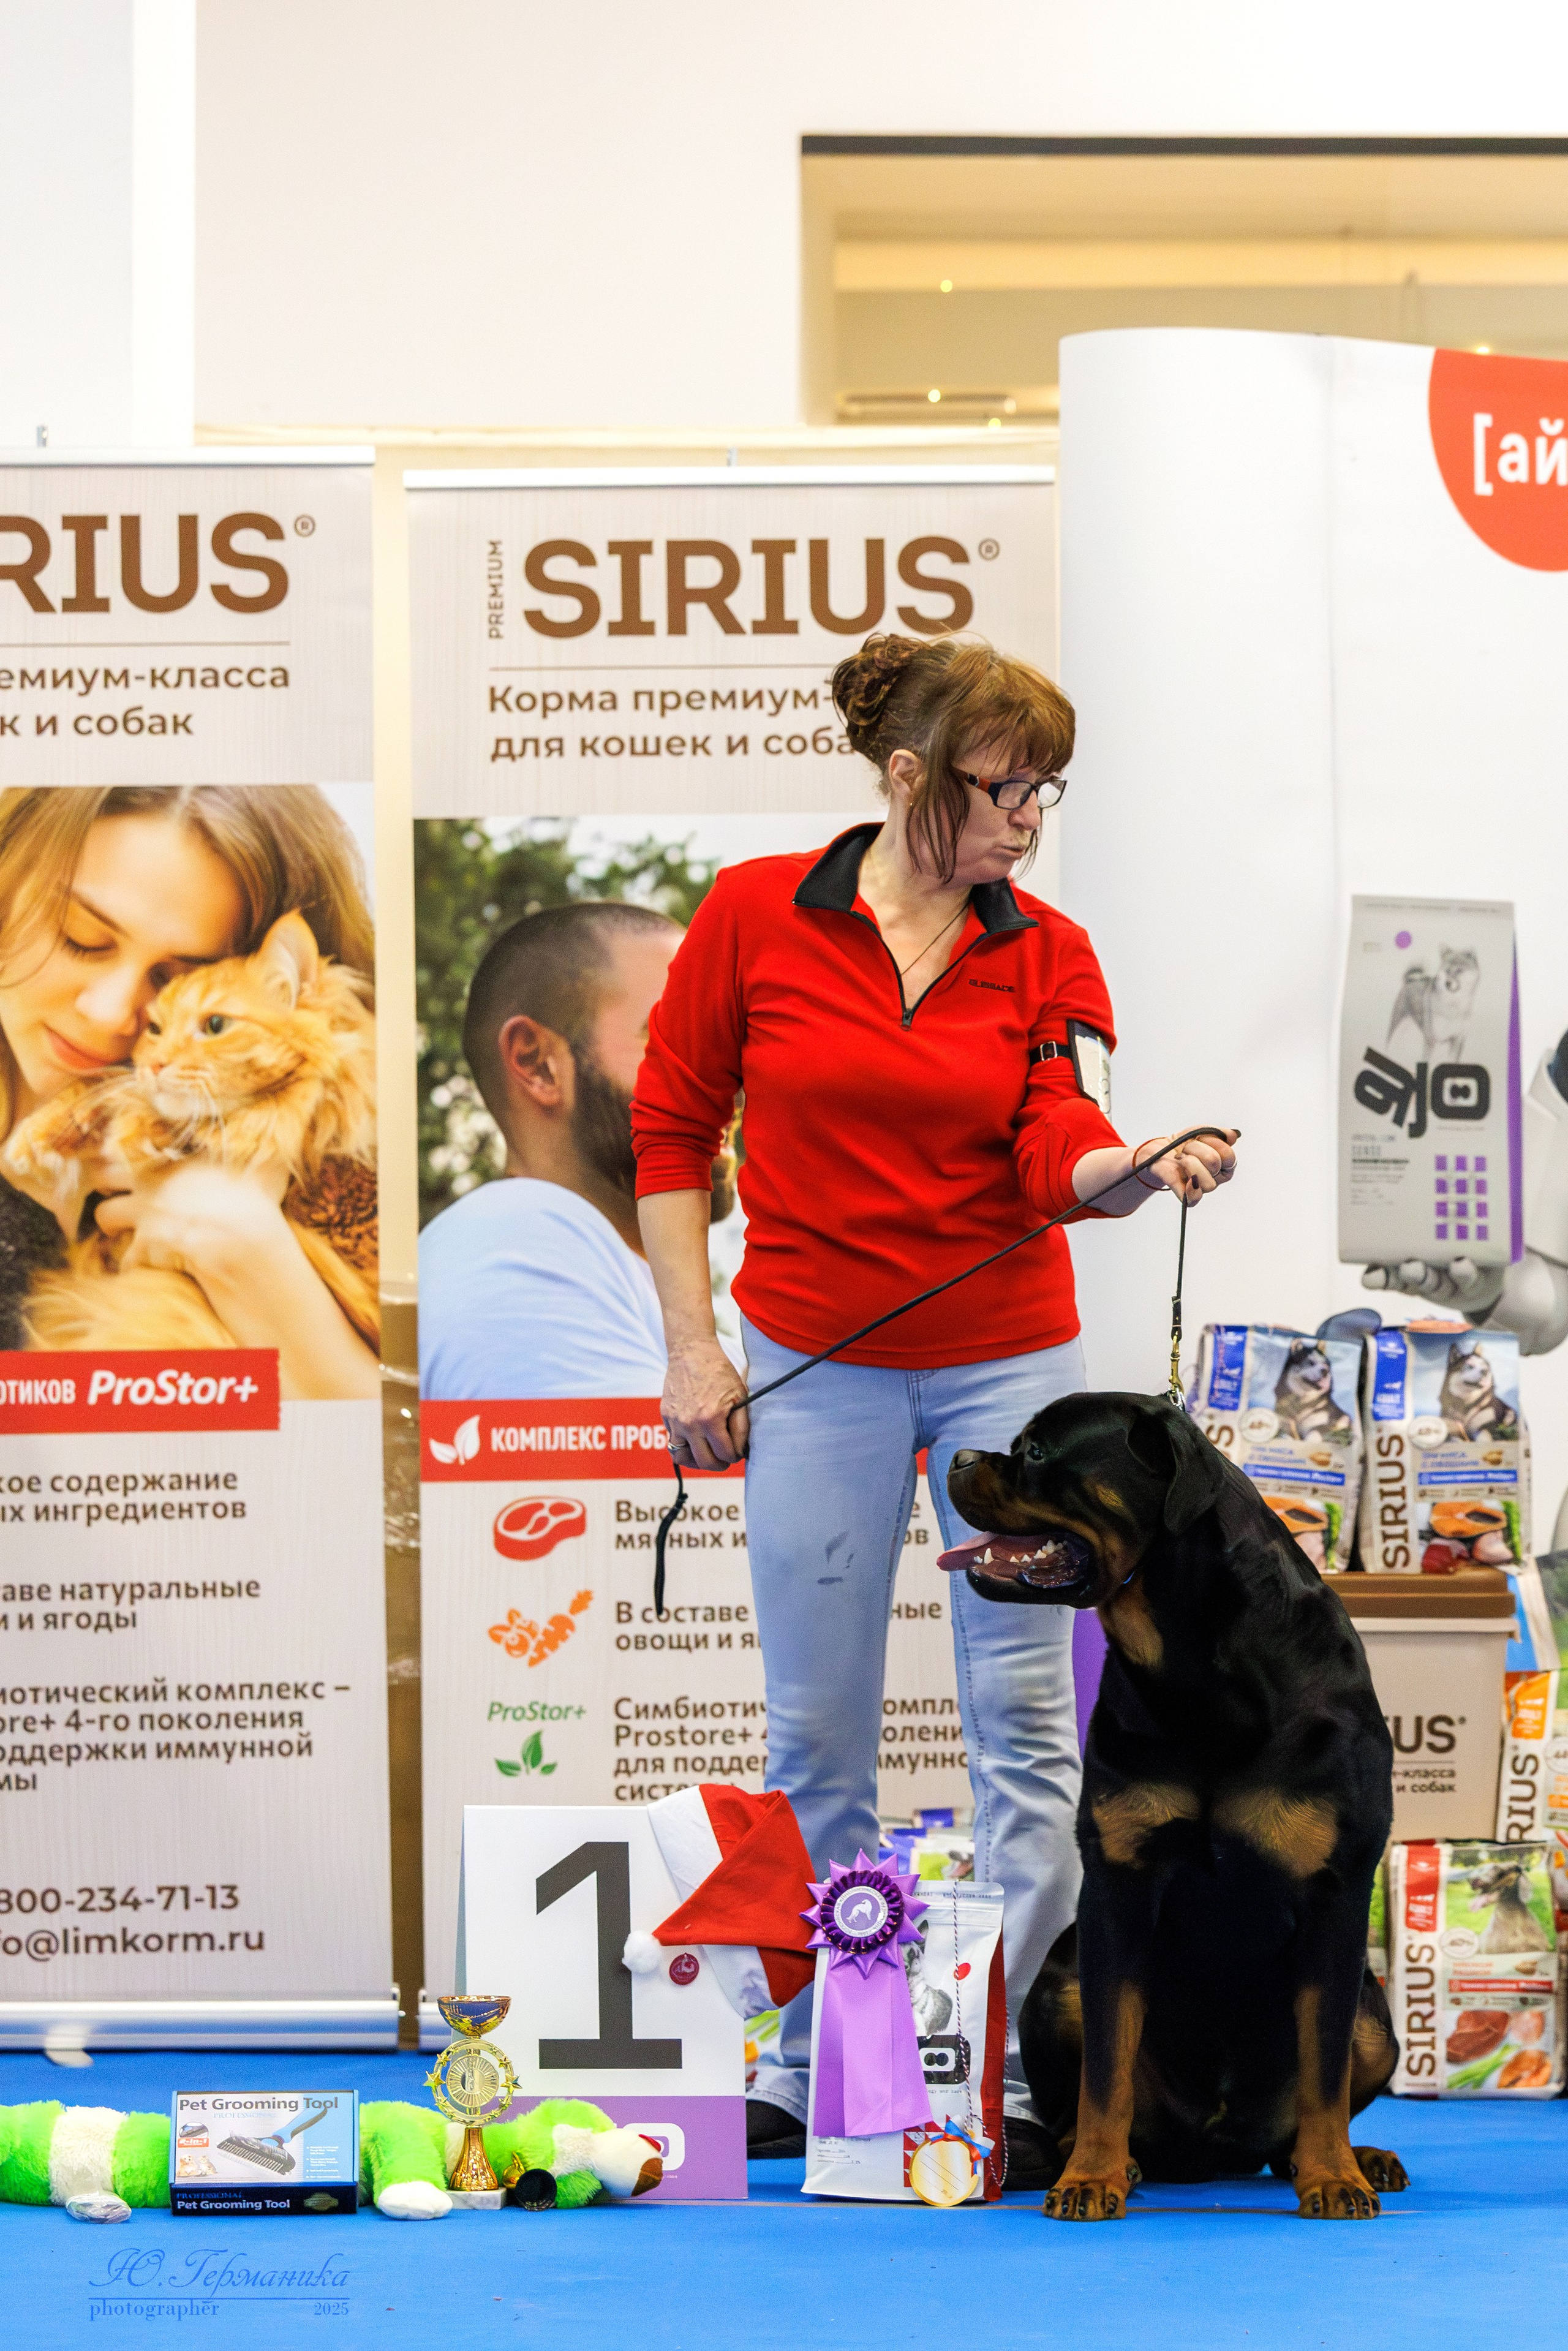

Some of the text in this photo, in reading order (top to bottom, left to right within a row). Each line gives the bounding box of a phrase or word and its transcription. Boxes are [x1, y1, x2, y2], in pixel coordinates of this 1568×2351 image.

[487, 539, 504, 639] PREMIUM
[489, 685, 618, 719] Корма
[36, 715, 58, 736] и
[73, 706, 192, 736] собак
[491, 725, 854, 763] для кошек и соба
[88, 1369, 258, 1405] ProStor+
[491, 1425, 669, 1452] КОМПЛЕКС ПРОБ
[50, 1473, 237, 1498] содержание
[34, 1501, 246, 1527] ингредиентов
[615, 1531, 725, 1550] мяных
[60, 1580, 260, 1607] натуральные
[18, 1610, 37, 1630] и
[43, 1612, 137, 1633] ягоды
[615, 1600, 750, 1625] В составе
[616, 1630, 712, 1655] овощи
[718, 1631, 736, 1648] и
[177, 1682, 324, 1702] комплекс
[64, 1708, 130, 1732] 4-го
[139, 1711, 303, 1731] поколения
[488, 1700, 587, 1722] ProStor+
[615, 1724, 752, 1746] Prostore+
[156, 1732, 312, 1764] иммунной
[613, 1757, 665, 1778] для
[1410, 1780, 1456, 1793] собак
[0, 1926, 264, 1962] o@limkorm.ru
[535, 1841, 683, 2069] 1
[1404, 1943, 1437, 2077] SIRIUS
[179, 2097, 339, 2111] Pet Grooming Tool
[176, 2198, 292, 2211] Pet Grooming Tool
